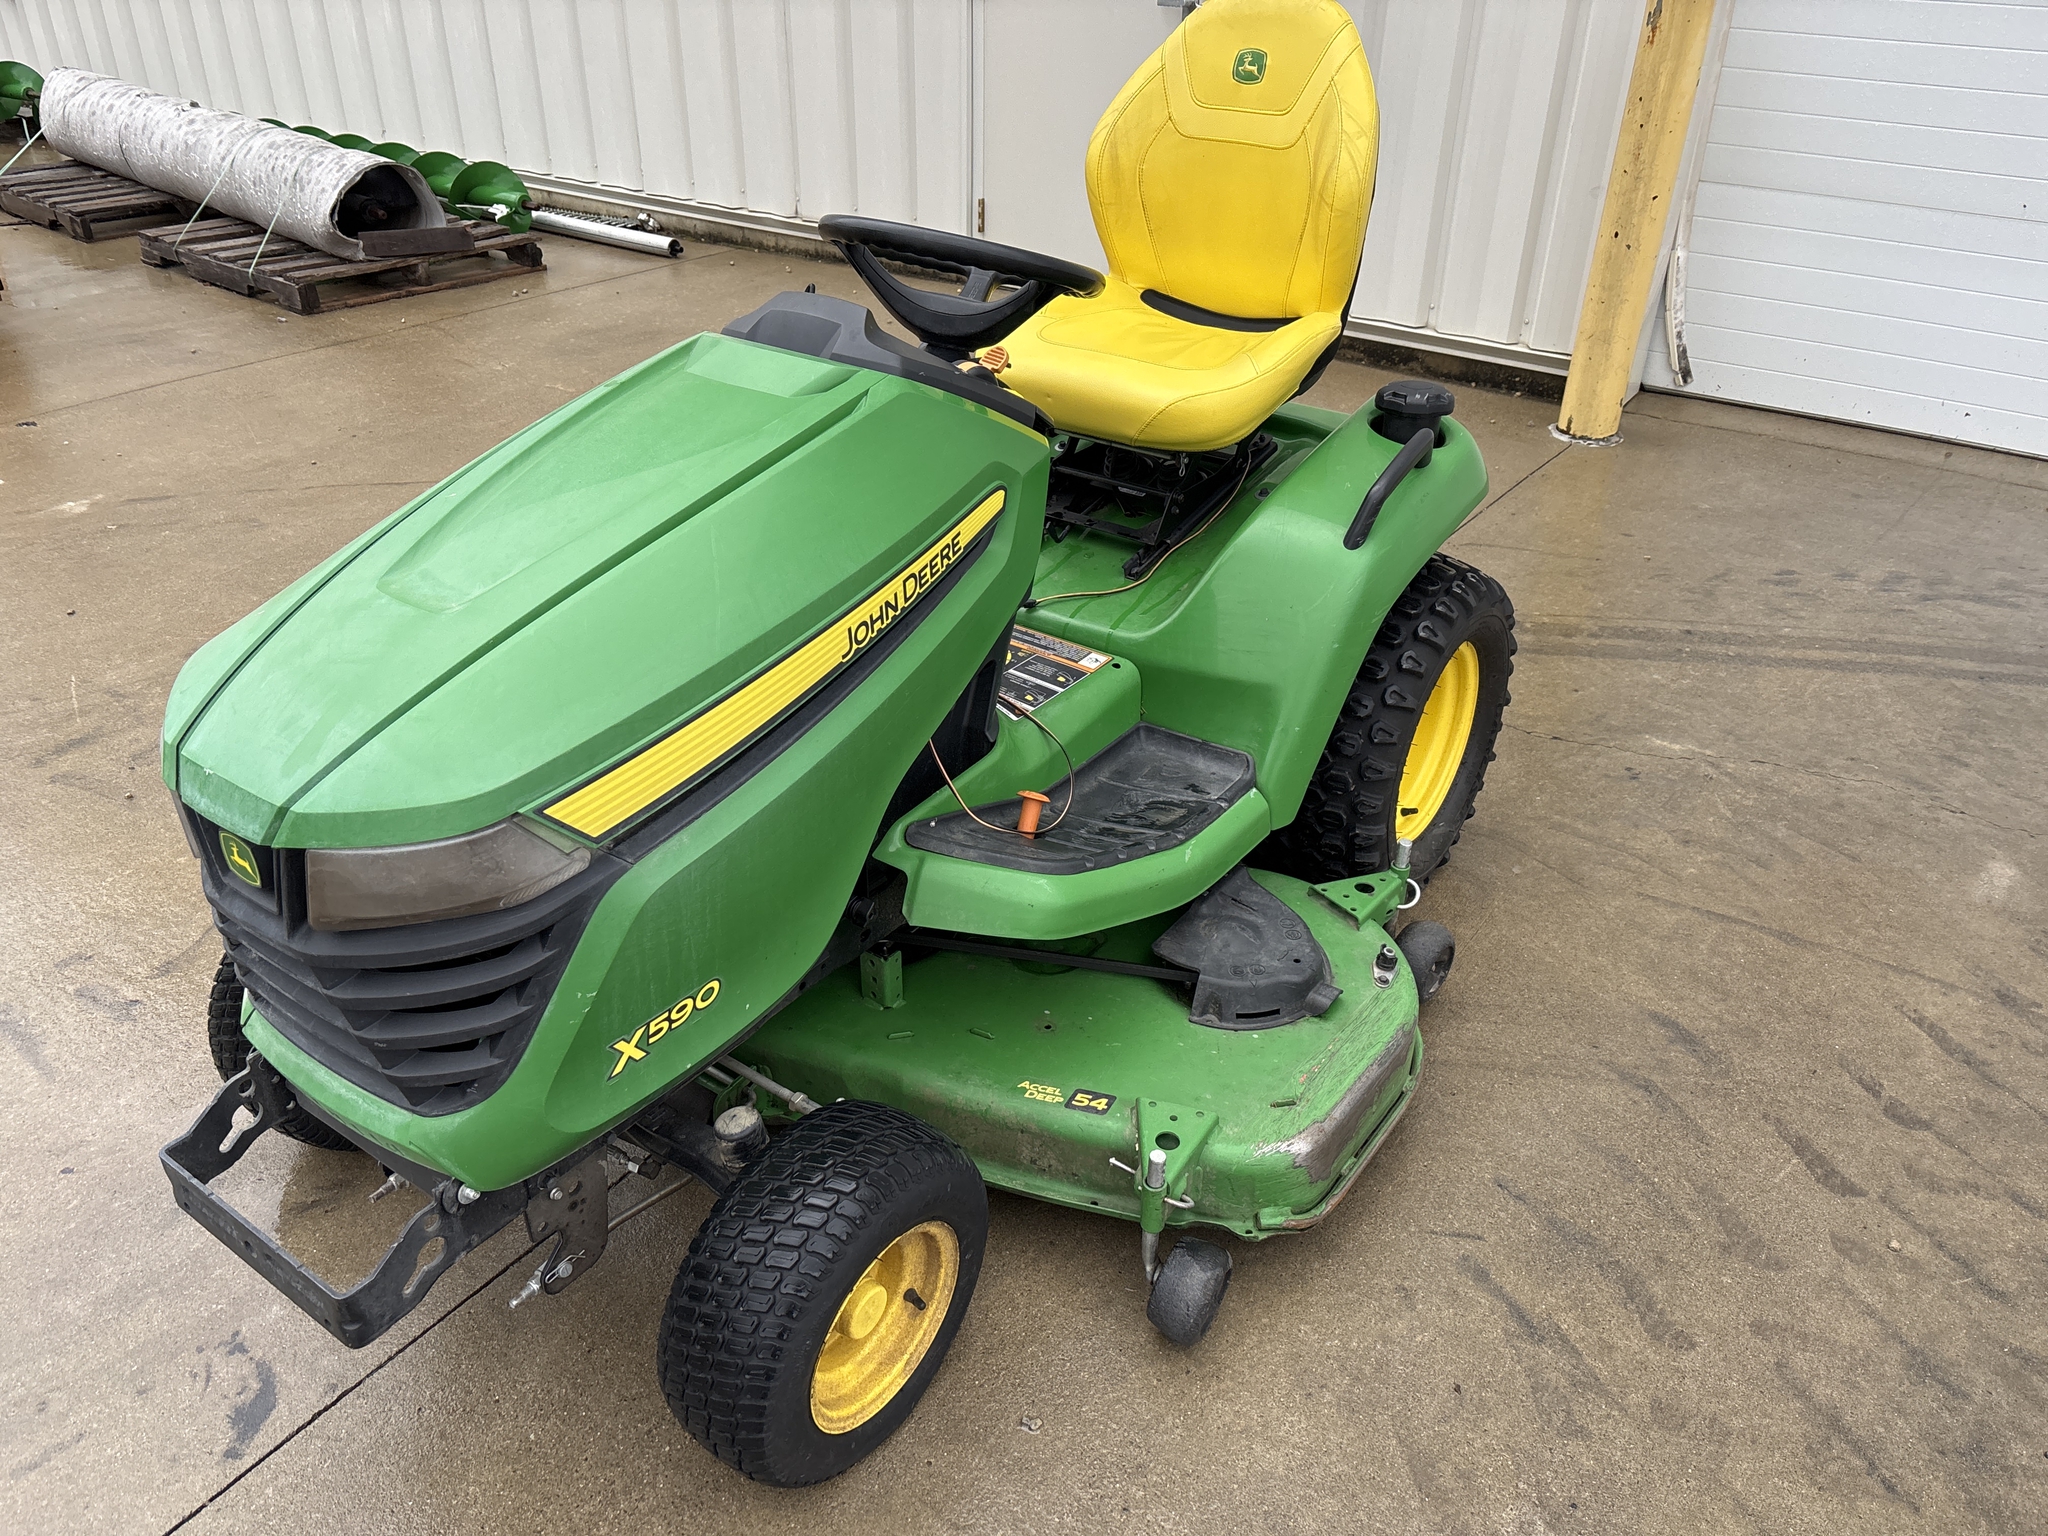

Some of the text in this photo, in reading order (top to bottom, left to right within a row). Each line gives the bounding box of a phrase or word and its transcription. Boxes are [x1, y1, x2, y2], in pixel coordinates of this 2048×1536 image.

[841, 530, 962, 661] JOHN DEERE
[608, 978, 721, 1080] X590
[1017, 1081, 1062, 1095] ACCEL
[1024, 1090, 1064, 1103] DEEP
[1072, 1093, 1108, 1110] 54
